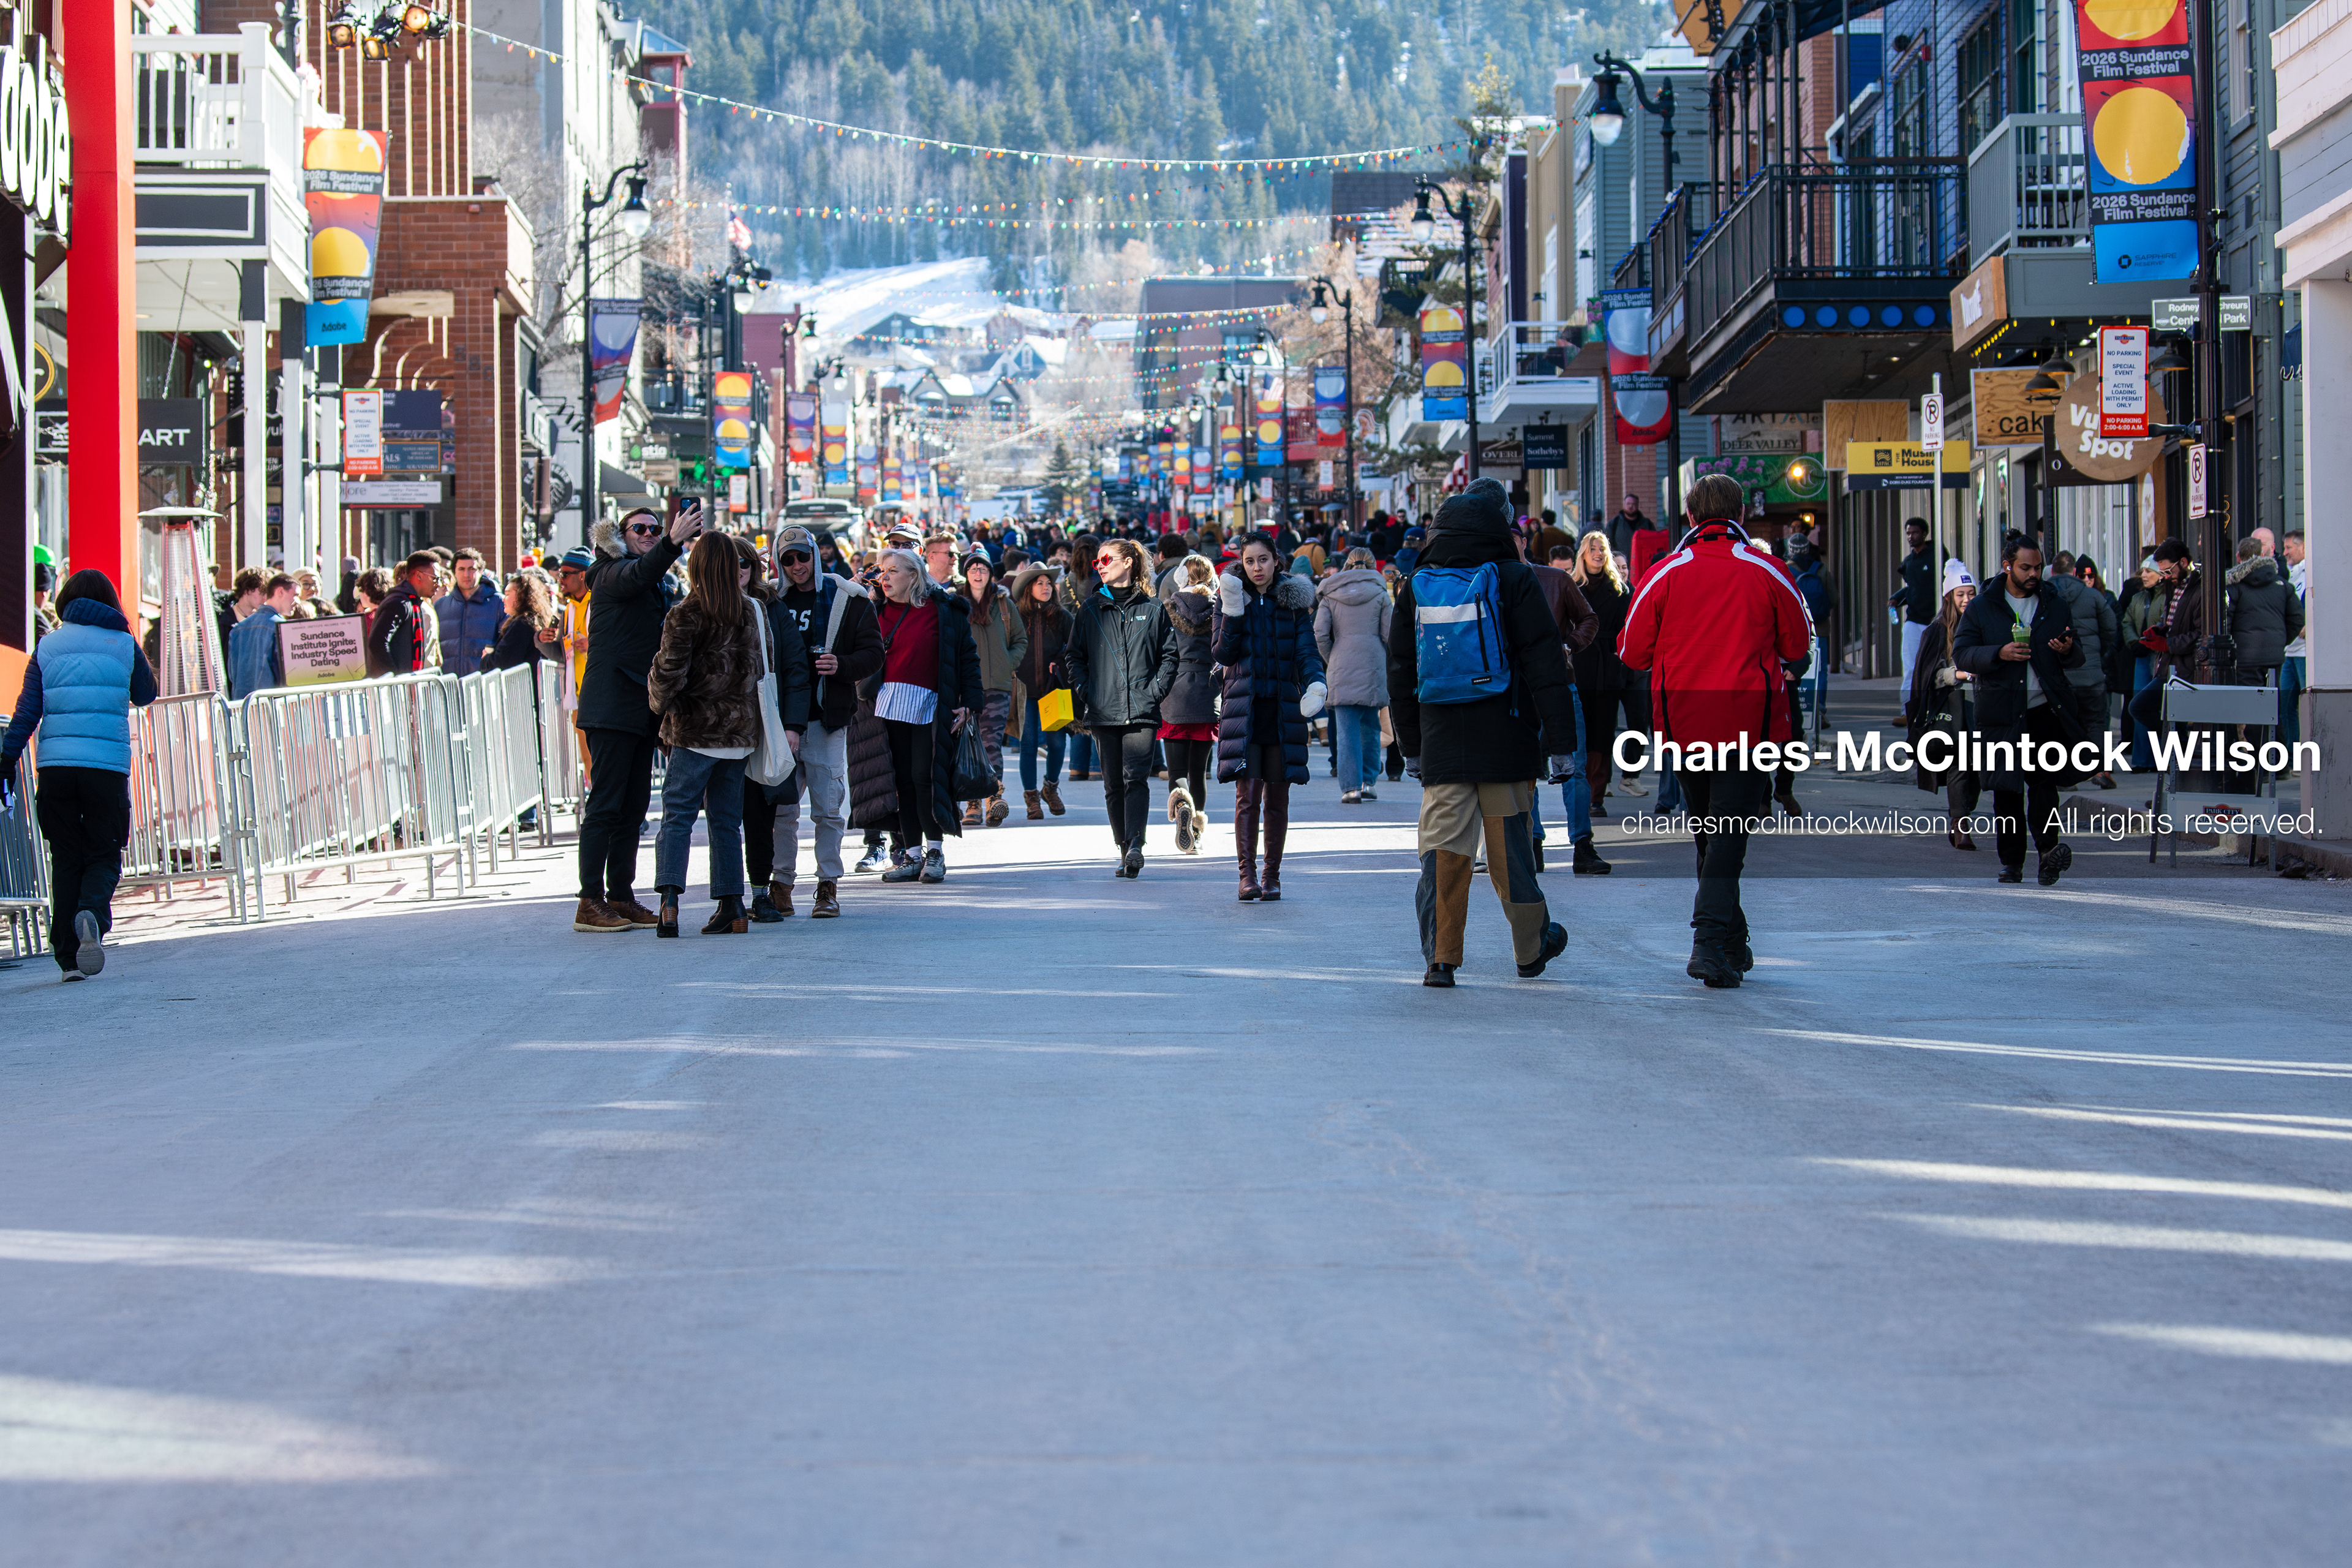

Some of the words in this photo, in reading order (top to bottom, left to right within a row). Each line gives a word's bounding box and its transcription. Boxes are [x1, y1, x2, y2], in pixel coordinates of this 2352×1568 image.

[2082, 52, 2117, 66] 2026
[2119, 49, 2190, 63] Sundance
[2093, 65, 2124, 77] Film
[2126, 61, 2179, 75] Festival
[0, 6, 70, 236] dobe
[304, 170, 328, 180] 2026
[329, 171, 383, 183] Sundance
[310, 180, 330, 190] Film
[332, 181, 374, 192] Festival
[2092, 195, 2128, 209] 2026
[2130, 192, 2196, 206] Sundance
[2104, 208, 2134, 220] Film
[2136, 204, 2187, 219] Festival
[323, 277, 370, 288] Sundance
[326, 288, 362, 297] Festival
[2169, 304, 2199, 313] Rodney
[2220, 301, 2248, 310] chreurs
[2223, 313, 2247, 323] Park
[322, 322, 347, 332] Adobe
[1999, 411, 2043, 433] cak
[137, 429, 191, 446] ART
[642, 444, 668, 456] stio
[1723, 440, 1754, 450] DEER
[1755, 439, 1798, 449] VALLEY
[2079, 430, 2134, 461] Spot
[1527, 447, 1564, 456] Sotheby's
[2192, 494, 2204, 502] PARKING
[300, 631, 345, 641] Sundance
[291, 641, 327, 650] Institute
[329, 638, 356, 649] Ignite:
[291, 650, 327, 660] Industry
[329, 646, 357, 657] Speed
[311, 658, 340, 666] Dating
